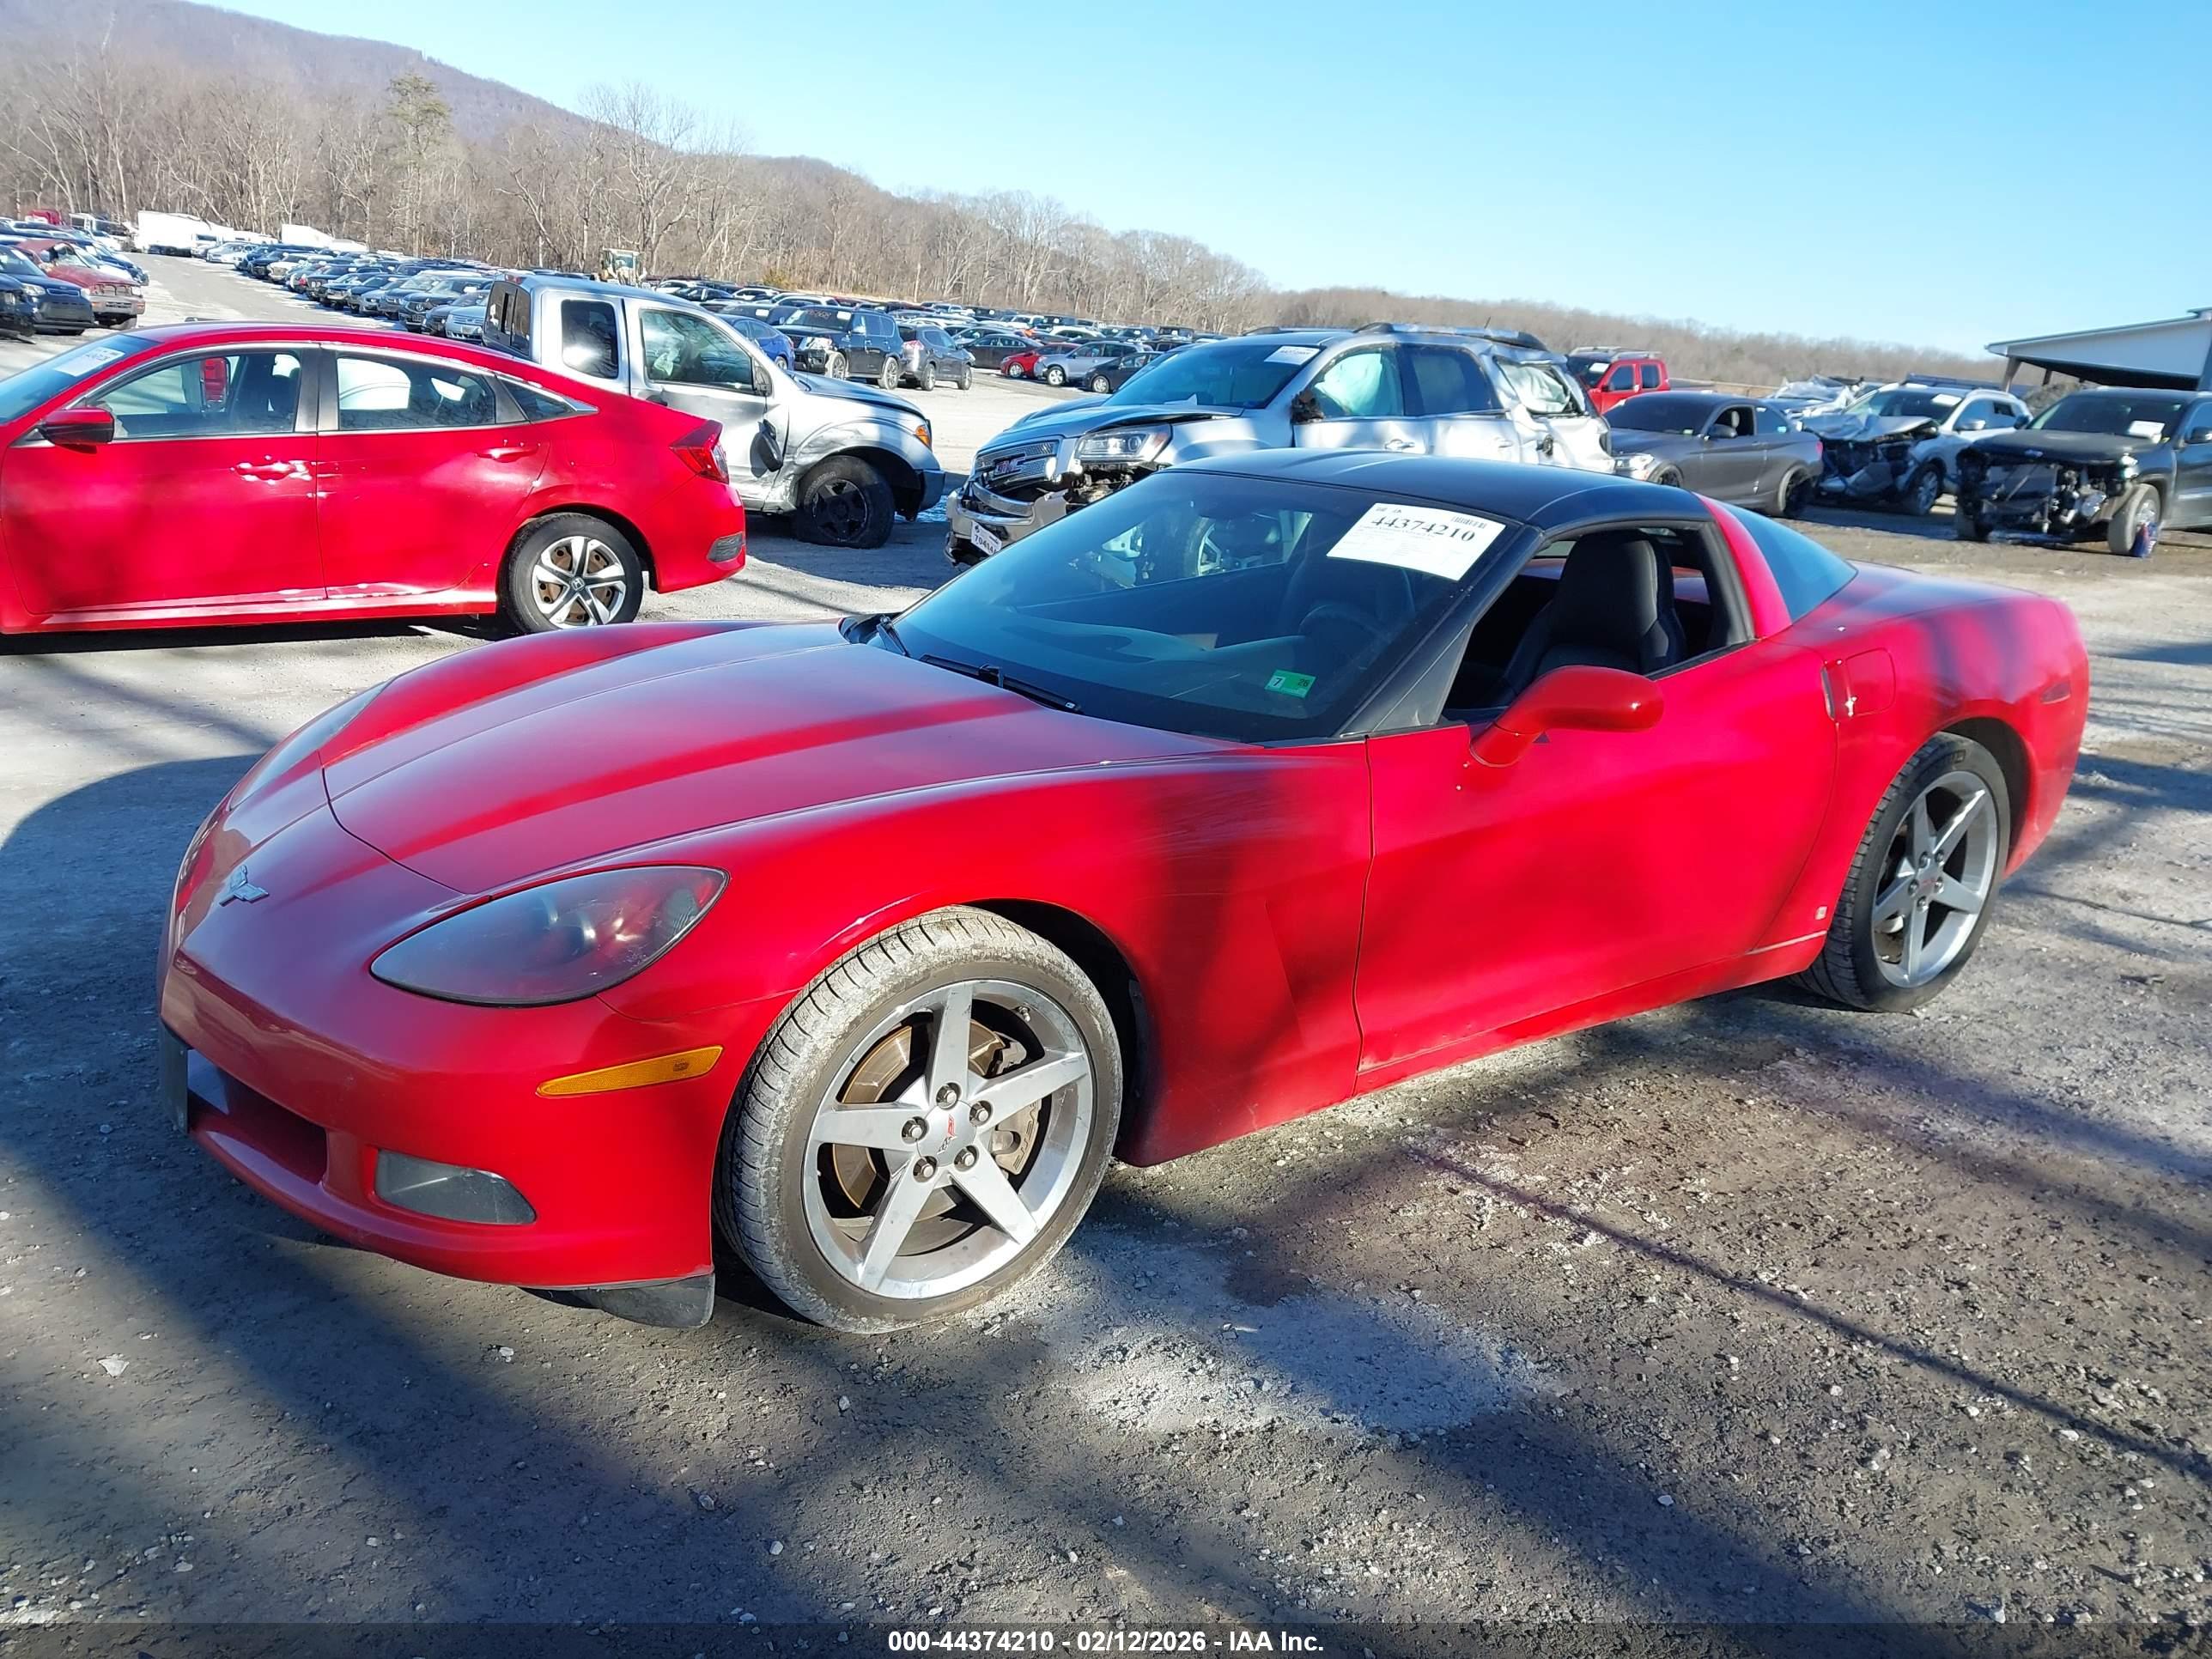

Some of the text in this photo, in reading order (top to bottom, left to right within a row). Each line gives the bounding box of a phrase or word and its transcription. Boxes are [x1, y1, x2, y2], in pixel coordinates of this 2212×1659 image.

[995, 457, 1026, 475] GMC
[1371, 516, 1476, 541] 44374210
[1273, 677, 1284, 687] 7
